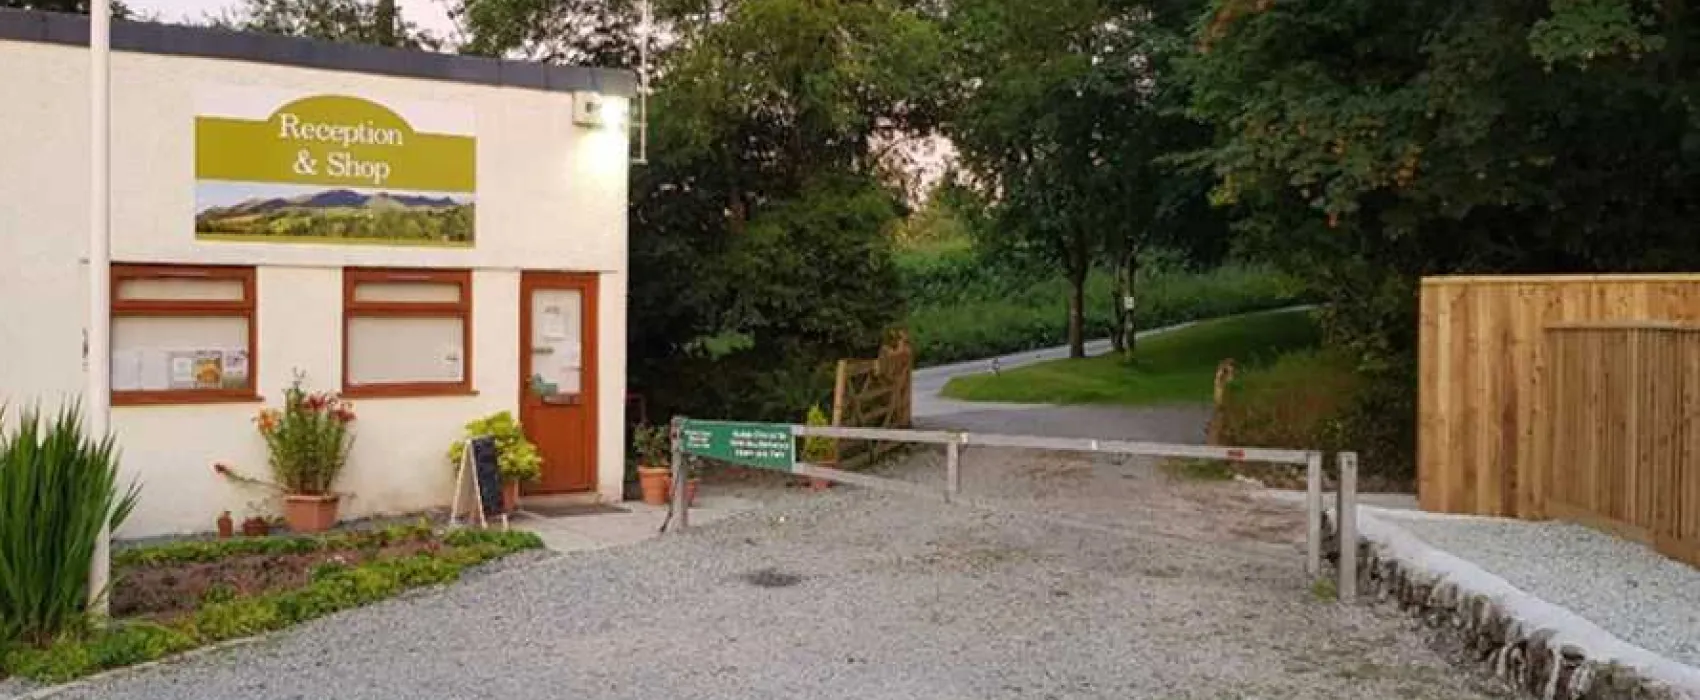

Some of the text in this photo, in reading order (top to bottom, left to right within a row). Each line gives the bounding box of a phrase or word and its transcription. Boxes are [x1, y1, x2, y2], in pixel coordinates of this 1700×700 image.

[279, 112, 403, 148] Reception
[292, 148, 391, 184] & Shop
